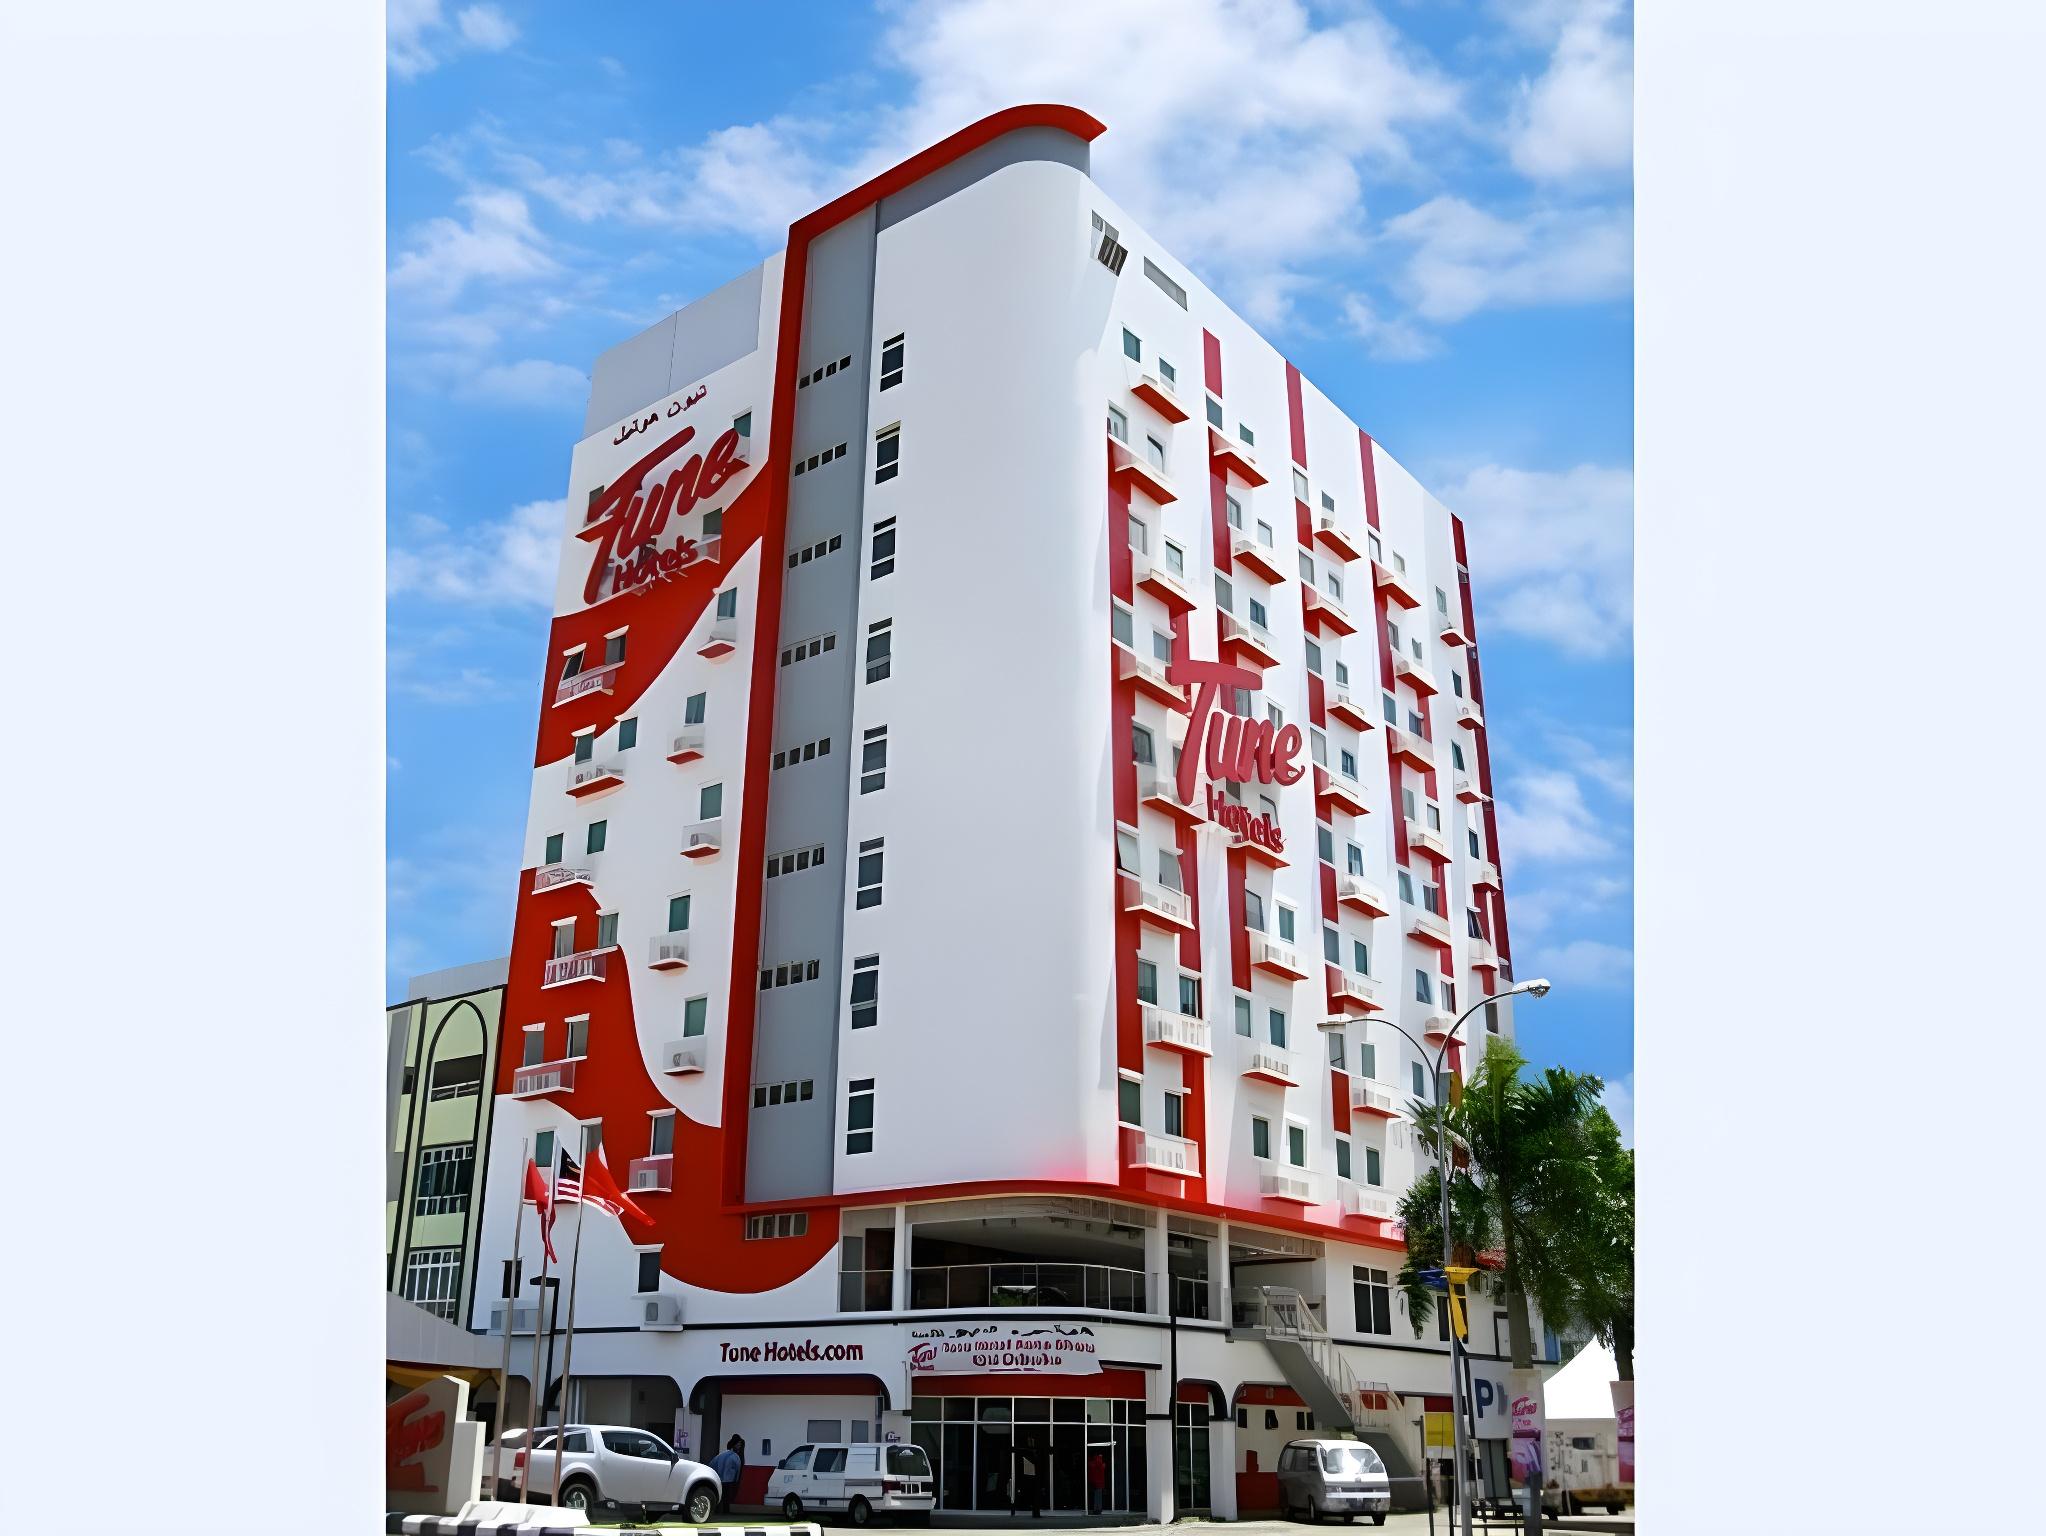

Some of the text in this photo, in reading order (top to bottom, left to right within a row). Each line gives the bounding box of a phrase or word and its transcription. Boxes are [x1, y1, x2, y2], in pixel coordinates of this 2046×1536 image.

[575, 425, 750, 606] Tune
[1165, 659, 1306, 806] Tune
[763, 1339, 864, 1362] Hotels.com
